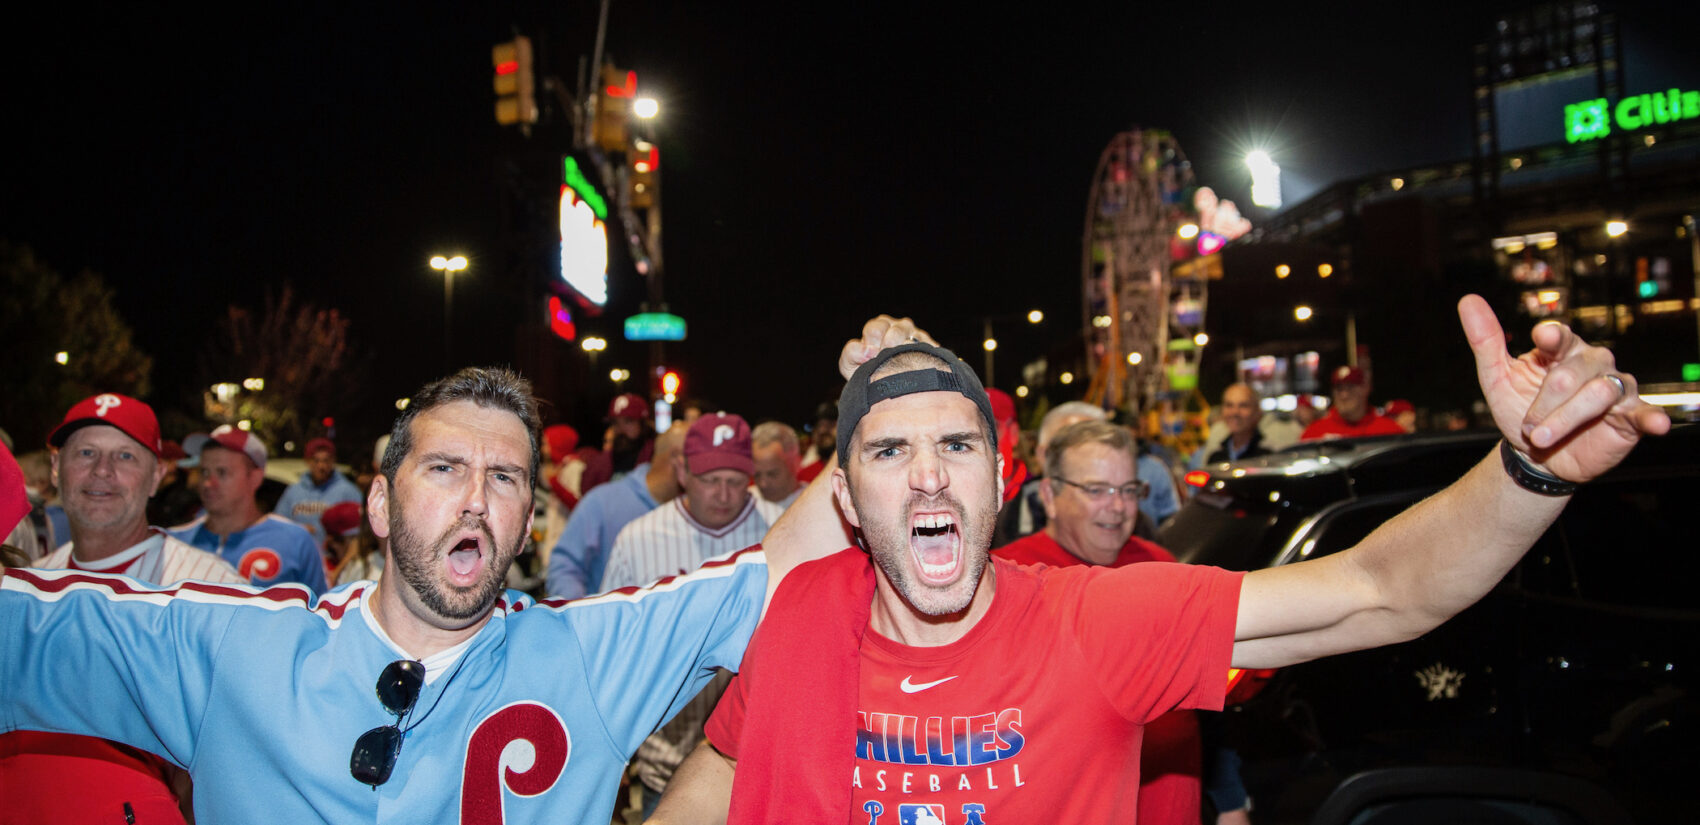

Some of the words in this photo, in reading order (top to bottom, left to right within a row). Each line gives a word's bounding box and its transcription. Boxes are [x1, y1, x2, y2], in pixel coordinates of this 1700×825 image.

[95, 393, 121, 417] P
[713, 424, 735, 447] P
[856, 708, 1025, 766] HILLIES
[852, 764, 1025, 793] ASEBALL
